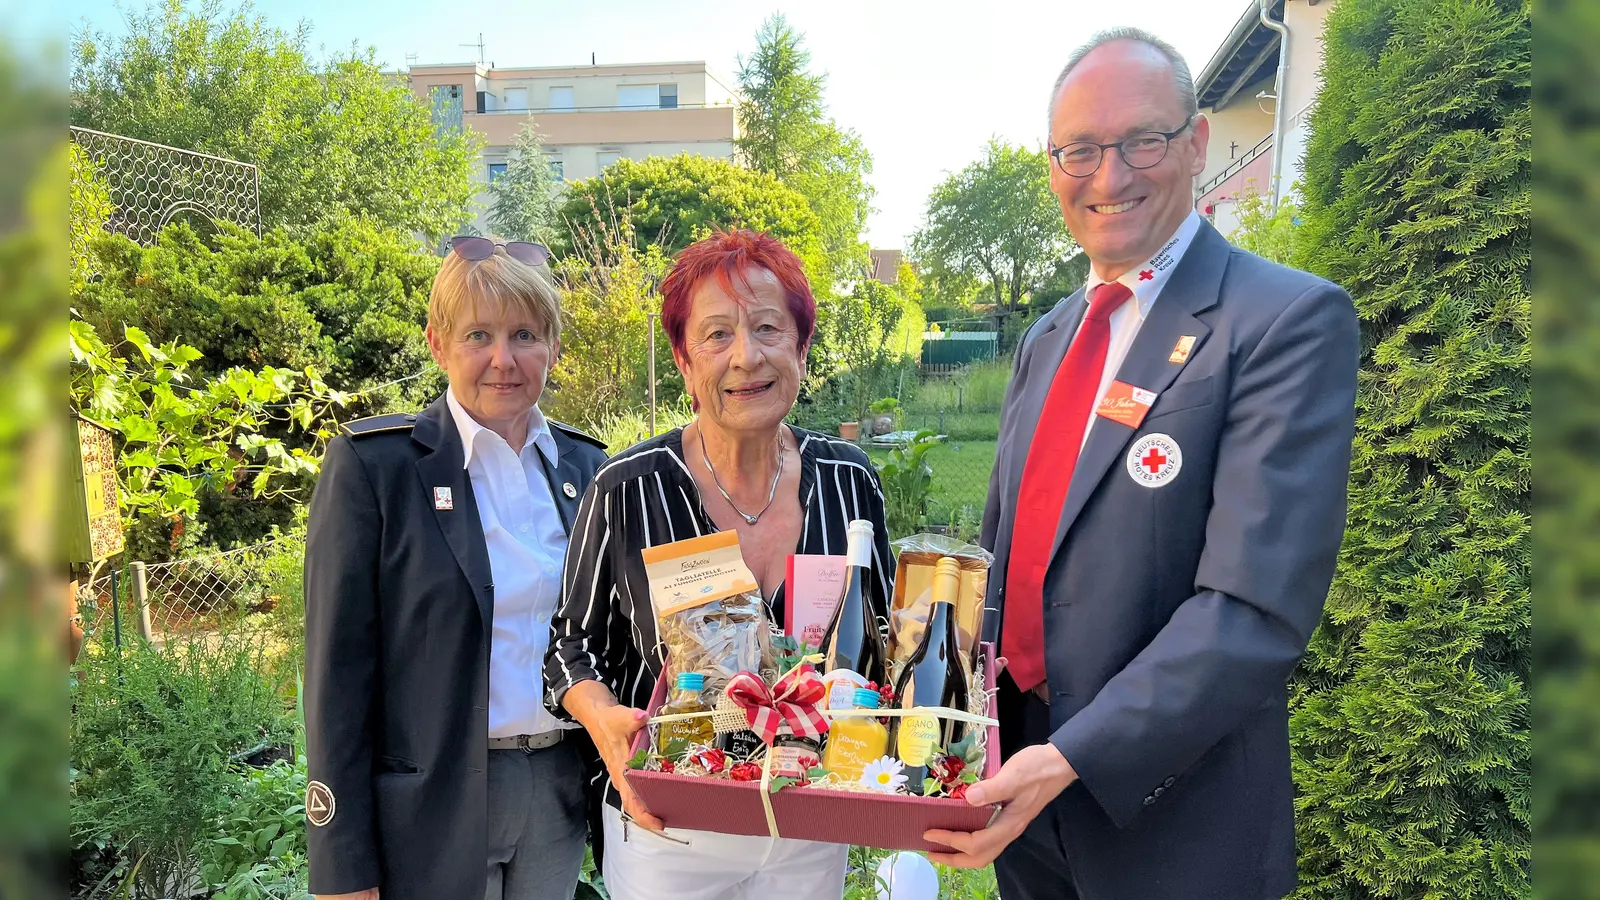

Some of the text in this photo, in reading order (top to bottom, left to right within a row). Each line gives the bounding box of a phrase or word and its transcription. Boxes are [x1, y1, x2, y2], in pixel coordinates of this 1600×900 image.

[1149, 237, 1180, 266] Bayerisches
[1135, 439, 1174, 458] DEUTSCHES
[1134, 458, 1175, 481] ROTES KREUZ
[675, 567, 722, 583] TAGLIATELLE
